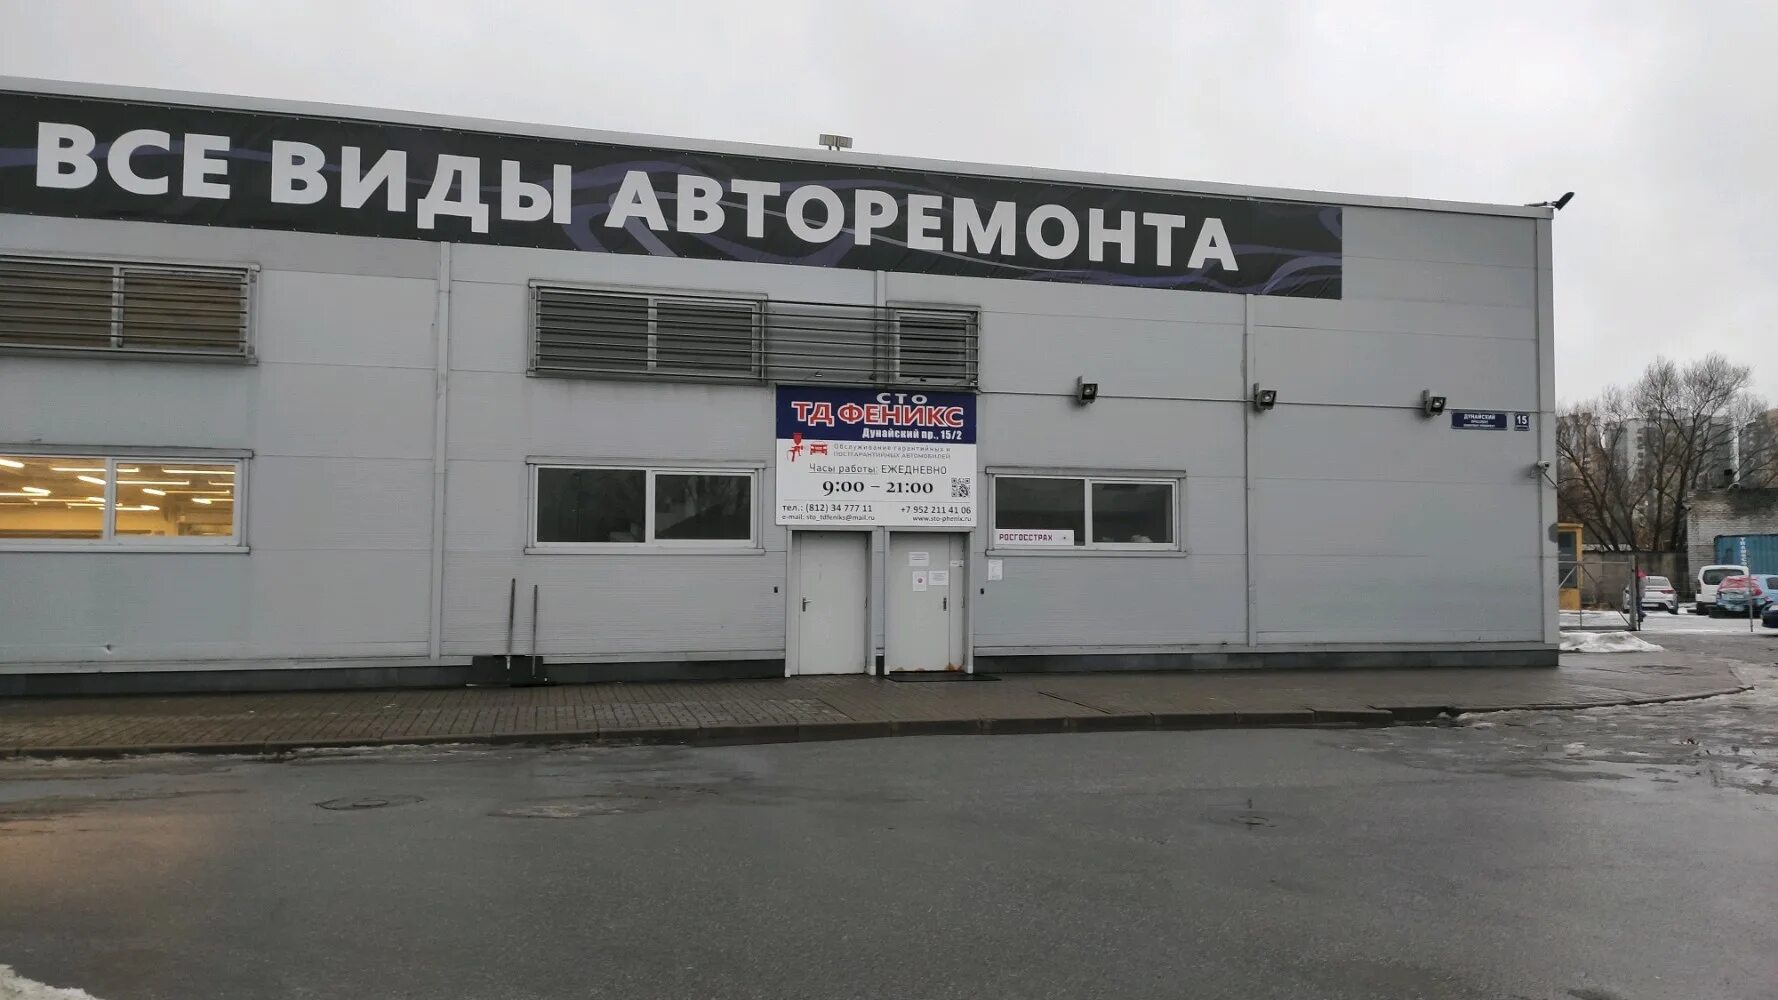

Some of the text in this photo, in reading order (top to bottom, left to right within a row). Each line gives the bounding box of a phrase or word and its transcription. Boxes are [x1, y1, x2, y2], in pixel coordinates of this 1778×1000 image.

[35, 121, 1239, 272] ВСЕ ВИДЫ АВТОРЕМОНТА
[876, 392, 928, 404] СТО
[791, 401, 963, 428] ТД ФЕНИКС
[1517, 415, 1527, 424] 15
[862, 427, 919, 440] Дунайский
[941, 430, 962, 441] 15/2
[833, 443, 892, 452] Обслуживание
[809, 463, 947, 475] Часы работы: ЕЖЕДНЕВНО
[822, 480, 864, 496] 9:00
[886, 481, 933, 494] 21:00
[782, 503, 872, 513] тел.: (812) 34 777 11
[913, 506, 929, 514] 952
[931, 506, 946, 514] 211
[961, 506, 972, 514] 06
[806, 514, 876, 522] sto_tdfeniks@mail.ru
[912, 515, 972, 523] www.sto-phenix.ru
[999, 533, 1053, 541] РОСГОССТРАХ
